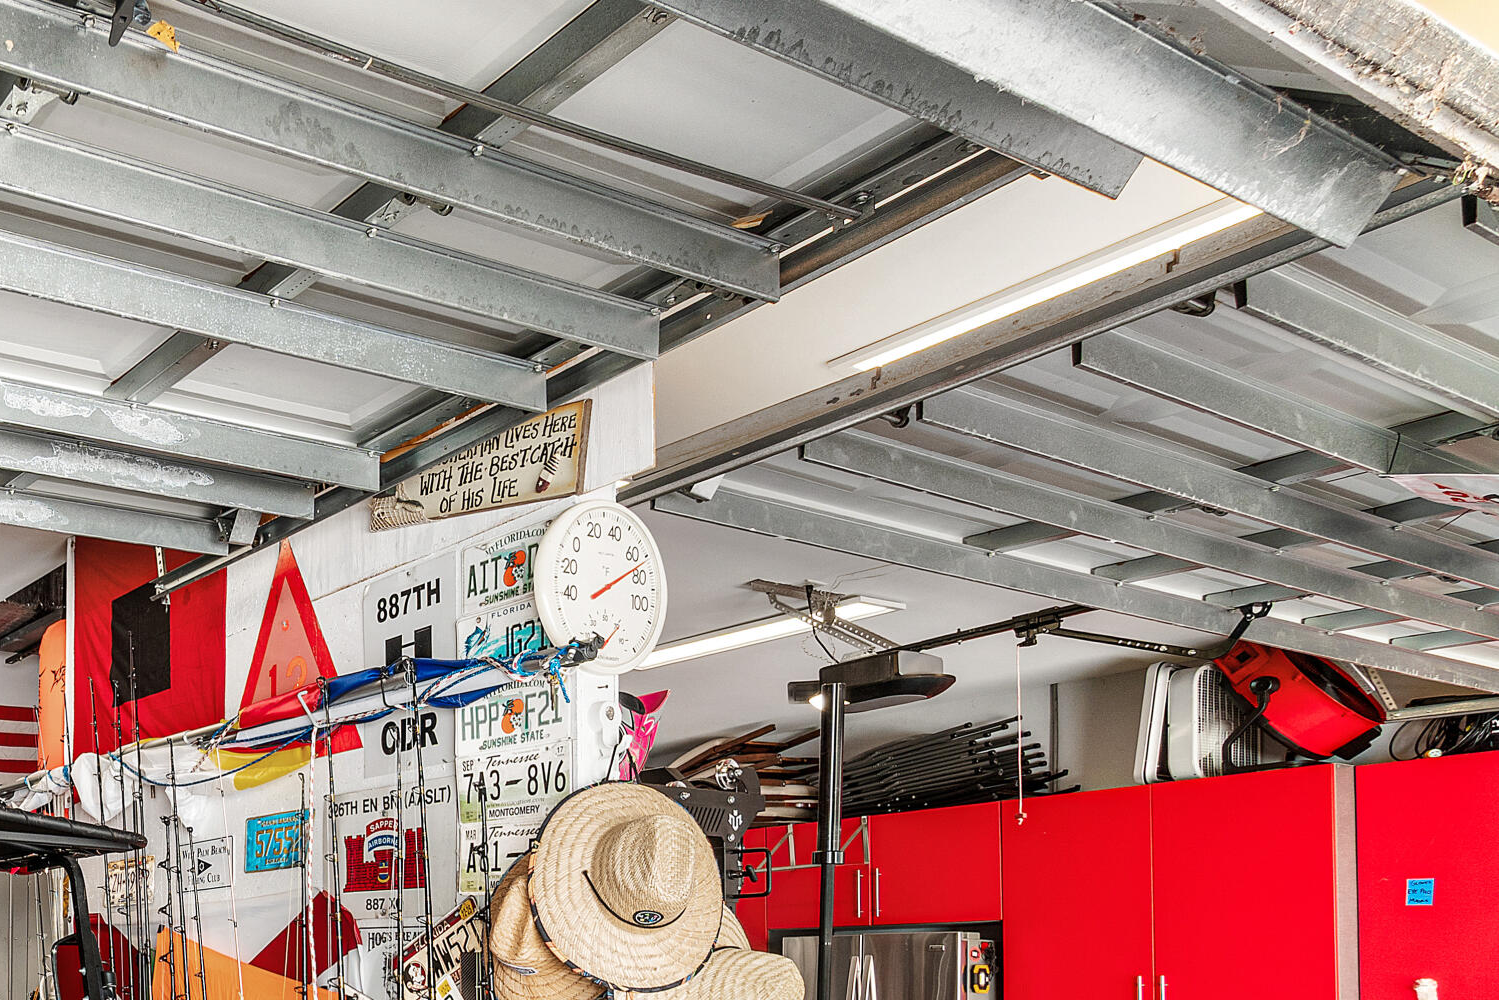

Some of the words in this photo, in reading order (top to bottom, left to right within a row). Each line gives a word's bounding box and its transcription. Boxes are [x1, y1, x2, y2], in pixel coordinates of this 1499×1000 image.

[504, 422, 540, 449] LIVES
[542, 413, 577, 438] HERE
[419, 465, 452, 496] WITH
[457, 460, 484, 487] THE
[489, 448, 529, 477] BEST
[529, 433, 578, 466] CATCH
[439, 493, 457, 513] OF
[461, 488, 485, 511] HIS
[490, 476, 519, 504] LIFE
[586, 521, 602, 539] 20
[608, 525, 622, 542] 40
[572, 536, 581, 553] 0
[625, 546, 639, 562] 60
[467, 555, 502, 599] AIT
[632, 568, 646, 585] 80
[377, 577, 441, 624] 887TH
[484, 586, 520, 606] SUNSHINE
[630, 594, 649, 611] 100
[491, 602, 532, 619] FLORIDA
[461, 701, 499, 741] HPP
[524, 688, 562, 730] F21
[482, 734, 517, 750] SUNSHINE
[521, 729, 544, 743] STATE
[462, 760, 474, 772] SEP
[486, 753, 540, 770] Tennessee
[527, 760, 566, 796] 8V6
[363, 798, 378, 814] EN
[488, 804, 540, 818] MONTGOMERY
[465, 829, 477, 840] MAR
[365, 898, 385, 911] 887
[368, 931, 392, 953] HOG'S
